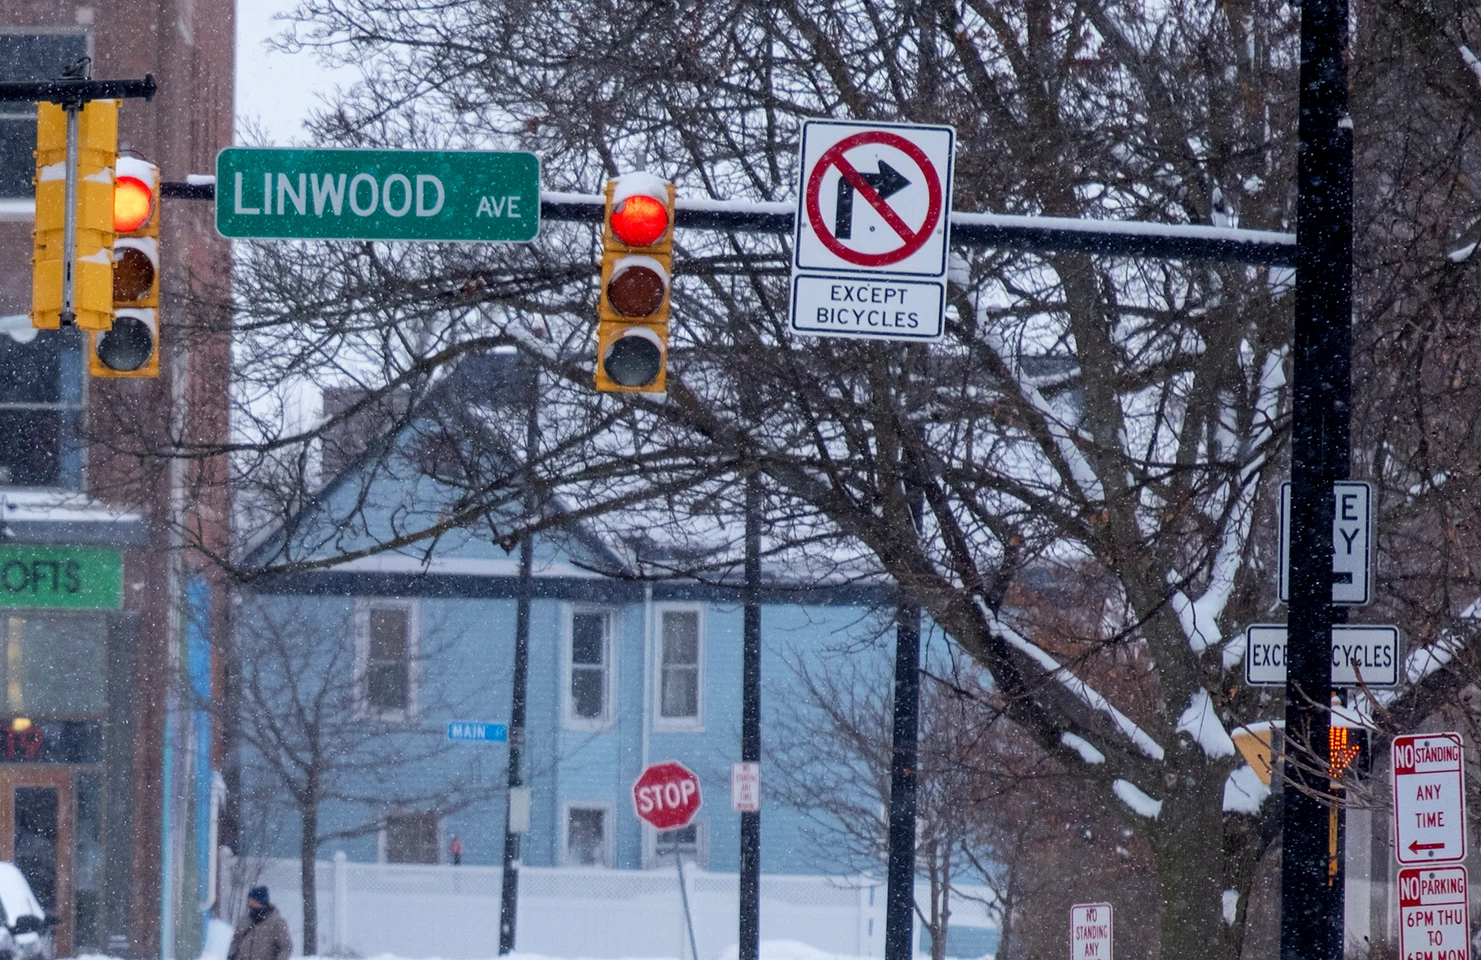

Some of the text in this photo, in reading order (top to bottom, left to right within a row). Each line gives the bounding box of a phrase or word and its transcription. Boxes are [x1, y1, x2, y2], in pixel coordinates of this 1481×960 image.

[234, 172, 521, 218] LINWOOD AVE
[831, 285, 908, 304] EXCEPT
[817, 307, 919, 329] BICYCLES
[1332, 645, 1392, 668] CYCLES
[452, 725, 486, 739] MAIN
[1395, 744, 1459, 769] NO STANDING
[639, 779, 696, 813] STOP
[1416, 784, 1442, 801] ANY
[1415, 812, 1445, 828] TIME
[1401, 877, 1464, 900] NO PARKING
[1086, 908, 1098, 922] NO
[1407, 909, 1463, 927] 6PM THU
[1076, 924, 1108, 940] STANDING
[1427, 930, 1443, 946] TO
[1084, 942, 1099, 957] ANY
